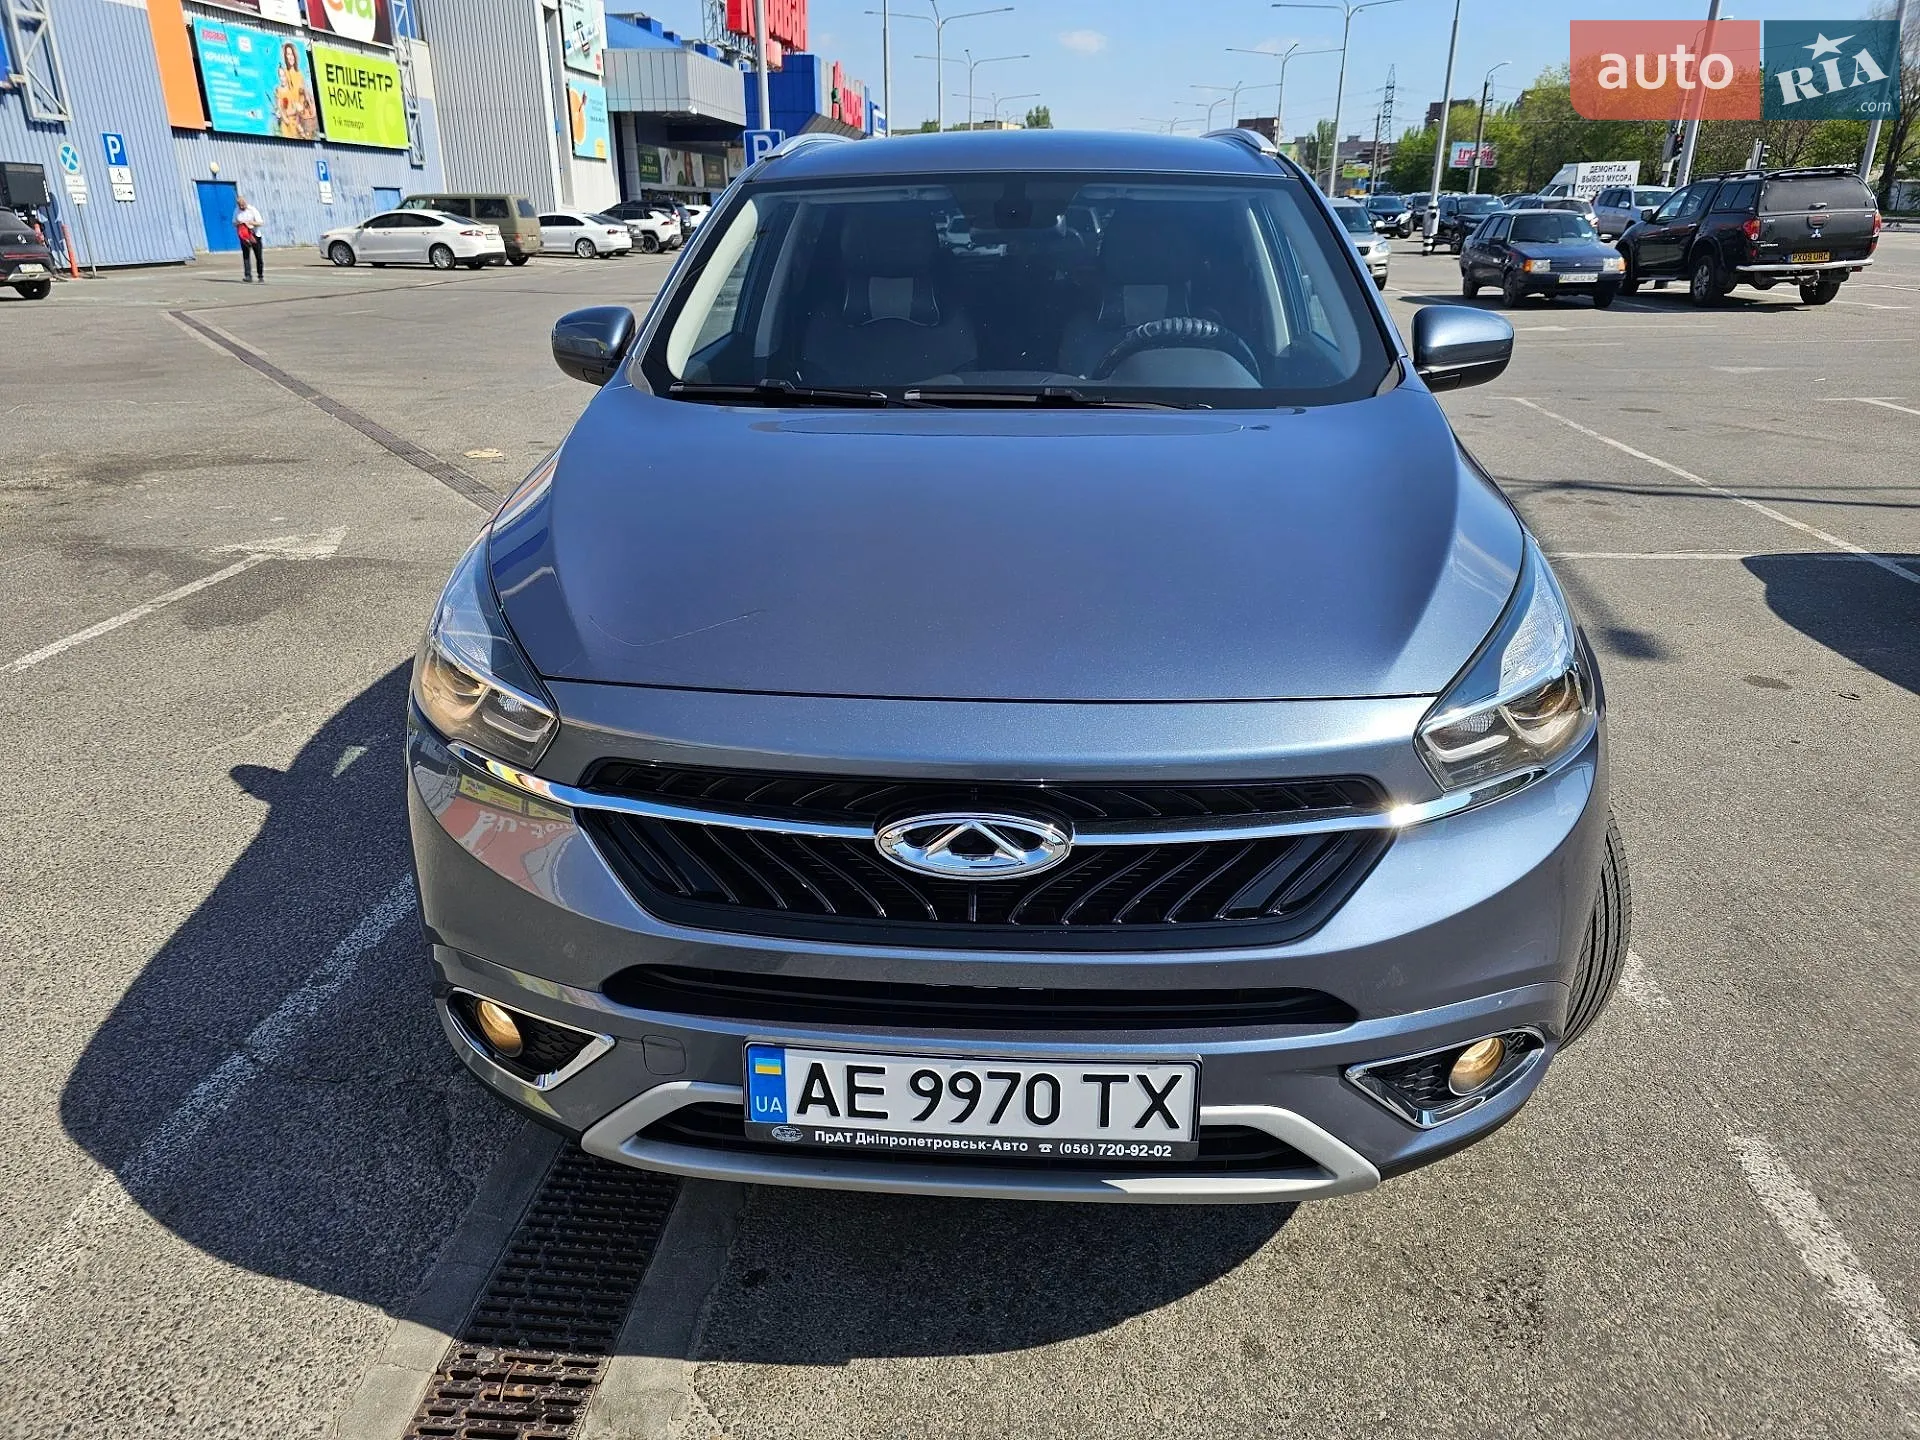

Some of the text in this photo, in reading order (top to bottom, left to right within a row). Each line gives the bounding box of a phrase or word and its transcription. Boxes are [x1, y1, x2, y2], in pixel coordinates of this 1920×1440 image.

[325, 63, 393, 92] ЕПІЦЕНТР
[328, 86, 364, 110] HOME
[106, 135, 121, 164] P
[753, 135, 773, 162] P
[1582, 174, 1632, 183] ВЫВОЗ МУСОРА
[1589, 164, 1627, 174] ДЕМОНТАЖ
[756, 1096, 783, 1113] UA
[796, 1062, 1183, 1129] AE 9970 TX
[815, 1130, 852, 1143] ПрАТ
[855, 1132, 1029, 1151] Дніпропетровськ-Авто
[1059, 1141, 1094, 1156] (056)
[1099, 1143, 1172, 1158] 720-92-02
